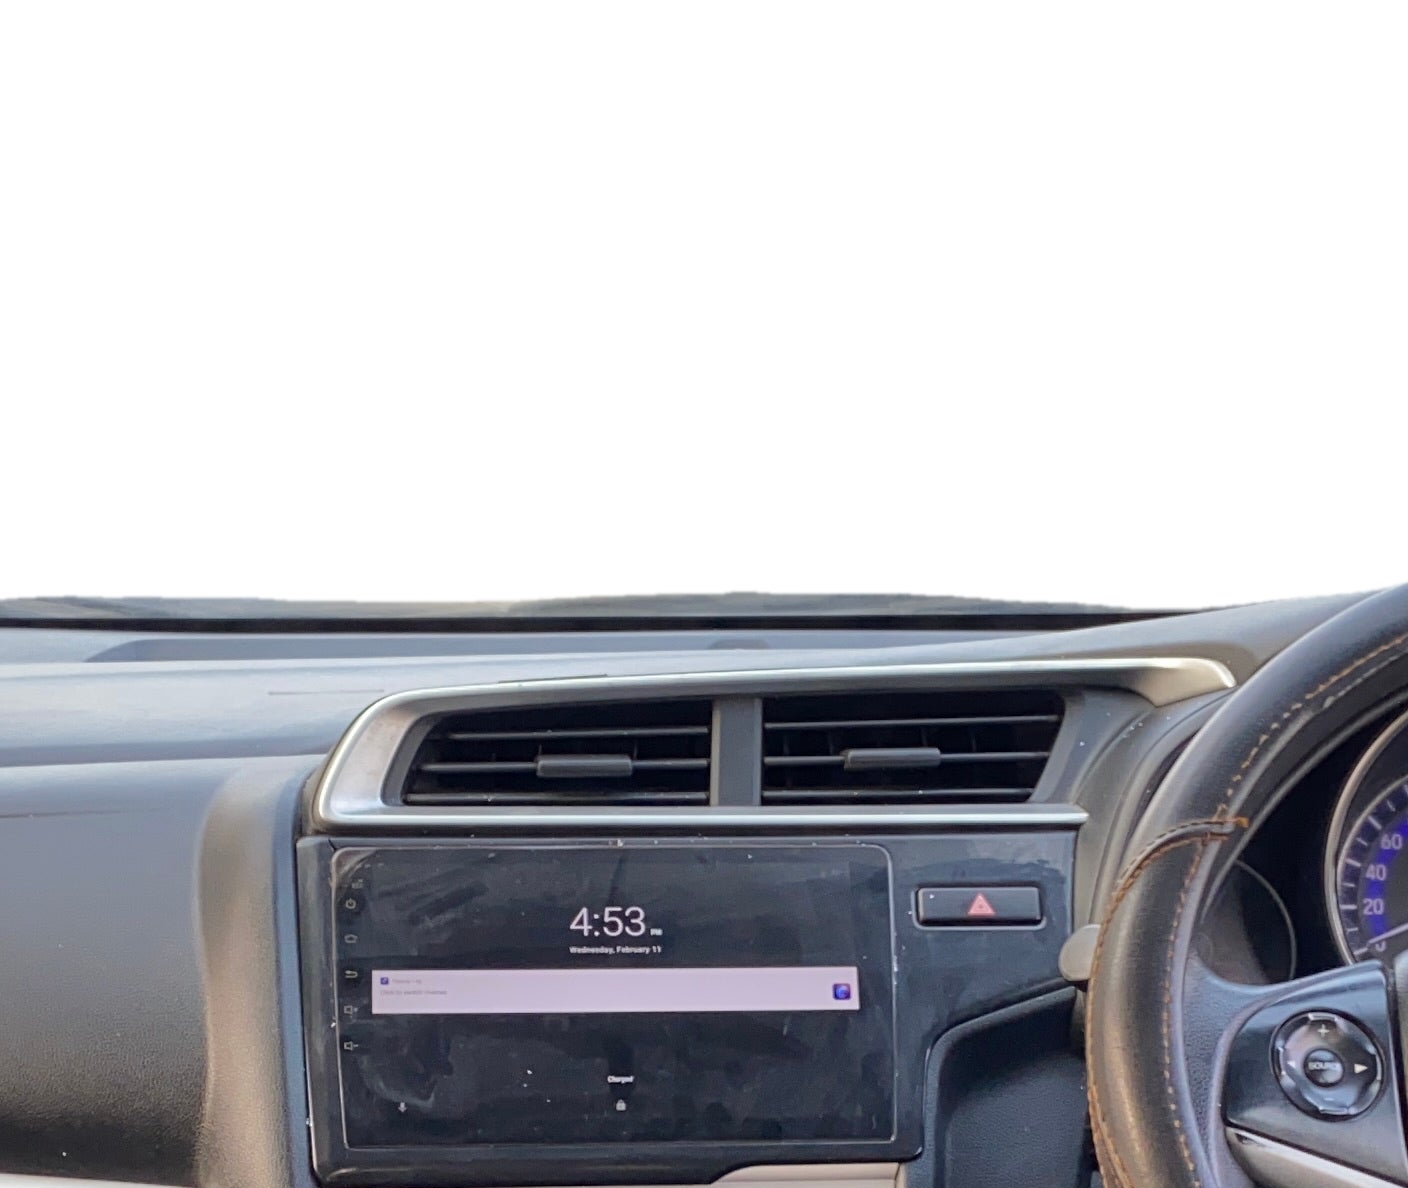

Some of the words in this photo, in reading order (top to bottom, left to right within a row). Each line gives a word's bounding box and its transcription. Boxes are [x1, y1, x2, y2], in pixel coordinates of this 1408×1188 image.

[1381, 834, 1403, 850] 60
[1366, 863, 1387, 881] 40
[1363, 898, 1385, 915] 20
[570, 906, 646, 937] 4:53
[617, 945, 650, 955] February
